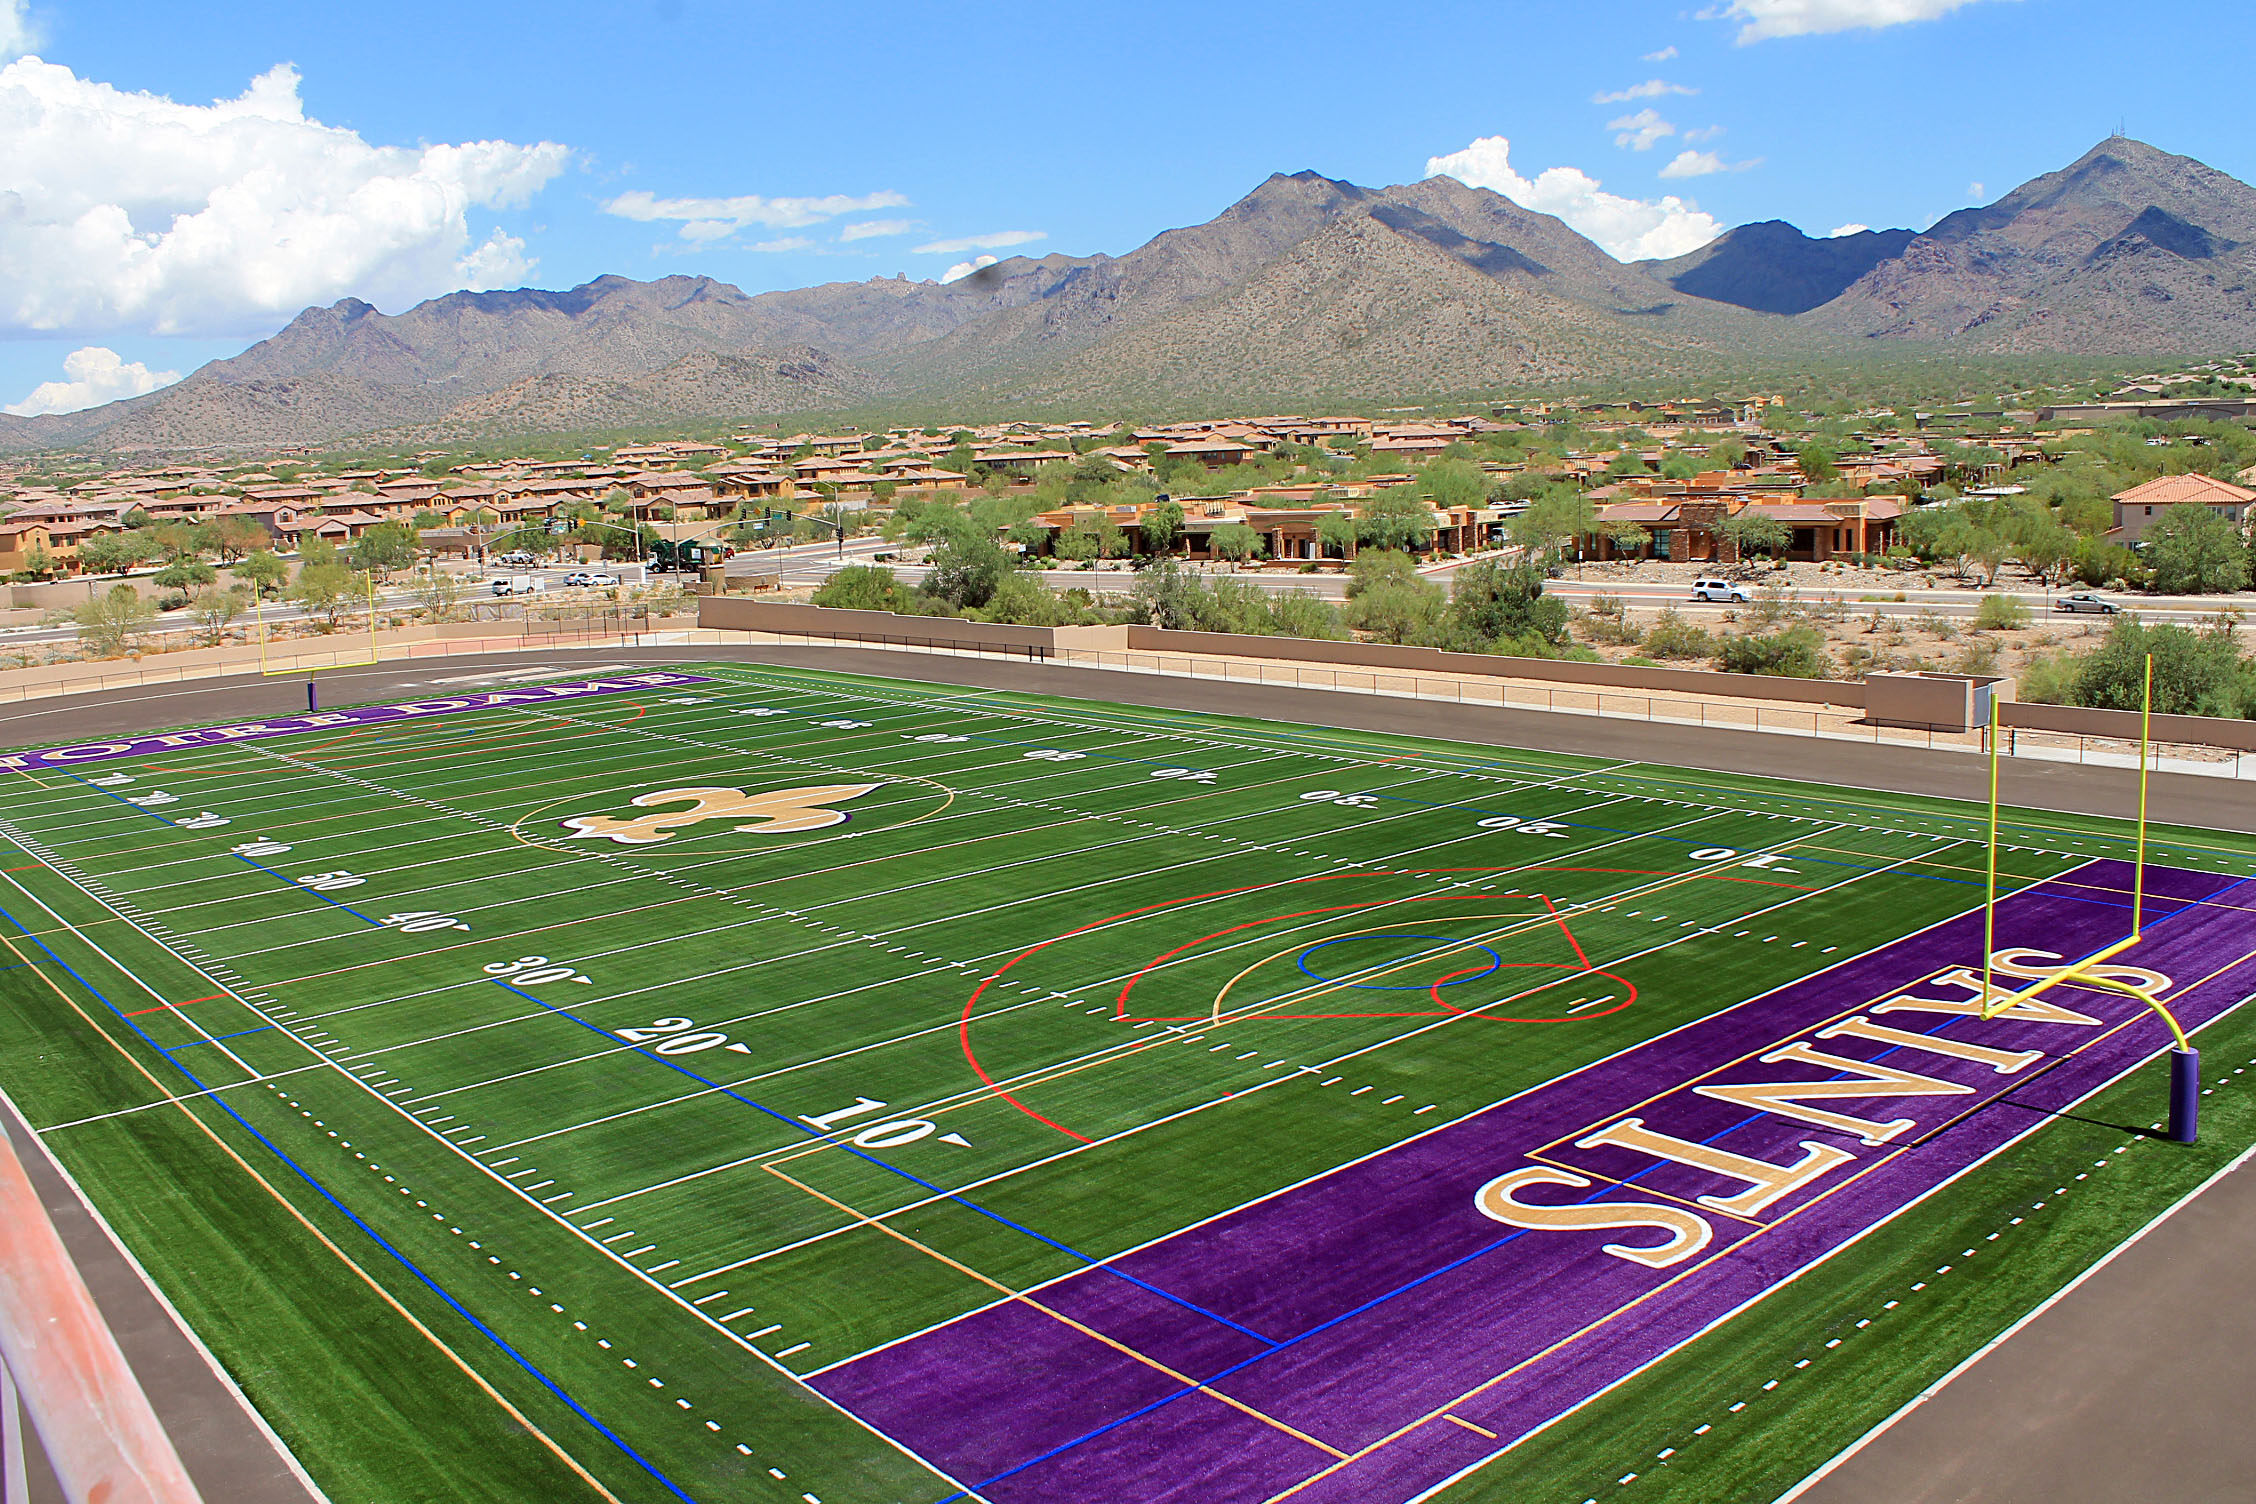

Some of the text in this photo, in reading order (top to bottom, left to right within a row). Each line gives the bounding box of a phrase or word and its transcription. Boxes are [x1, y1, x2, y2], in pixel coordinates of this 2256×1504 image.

[1300, 789, 1379, 807] 30
[1477, 816, 1567, 835] 20
[1688, 847, 1793, 870] 10
[297, 870, 367, 891] 50
[379, 910, 459, 932] 40
[482, 955, 576, 987] 30
[614, 1016, 728, 1056] 20
[1475, 947, 2174, 1269] SAINTS
[796, 1096, 937, 1149] 10
